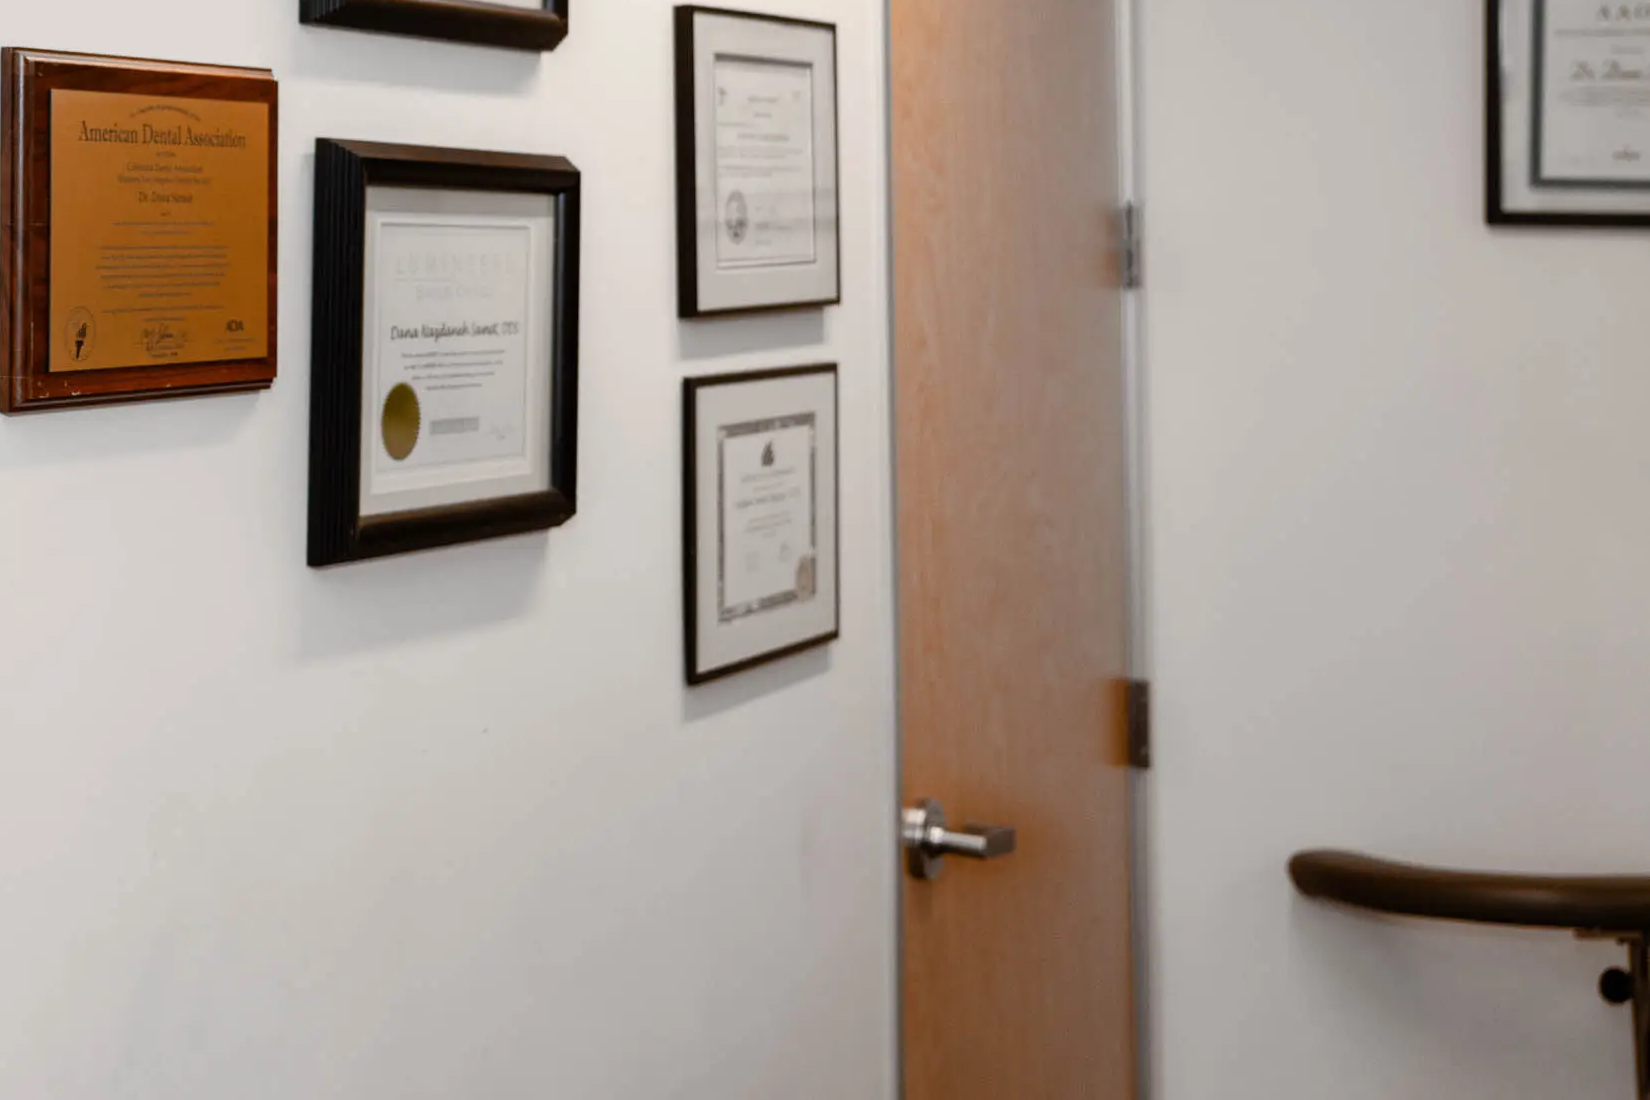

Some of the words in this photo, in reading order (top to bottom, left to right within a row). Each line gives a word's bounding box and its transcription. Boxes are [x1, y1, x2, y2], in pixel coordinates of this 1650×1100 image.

[78, 119, 139, 145] American
[142, 122, 181, 147] Dental
[184, 124, 247, 149] Association
